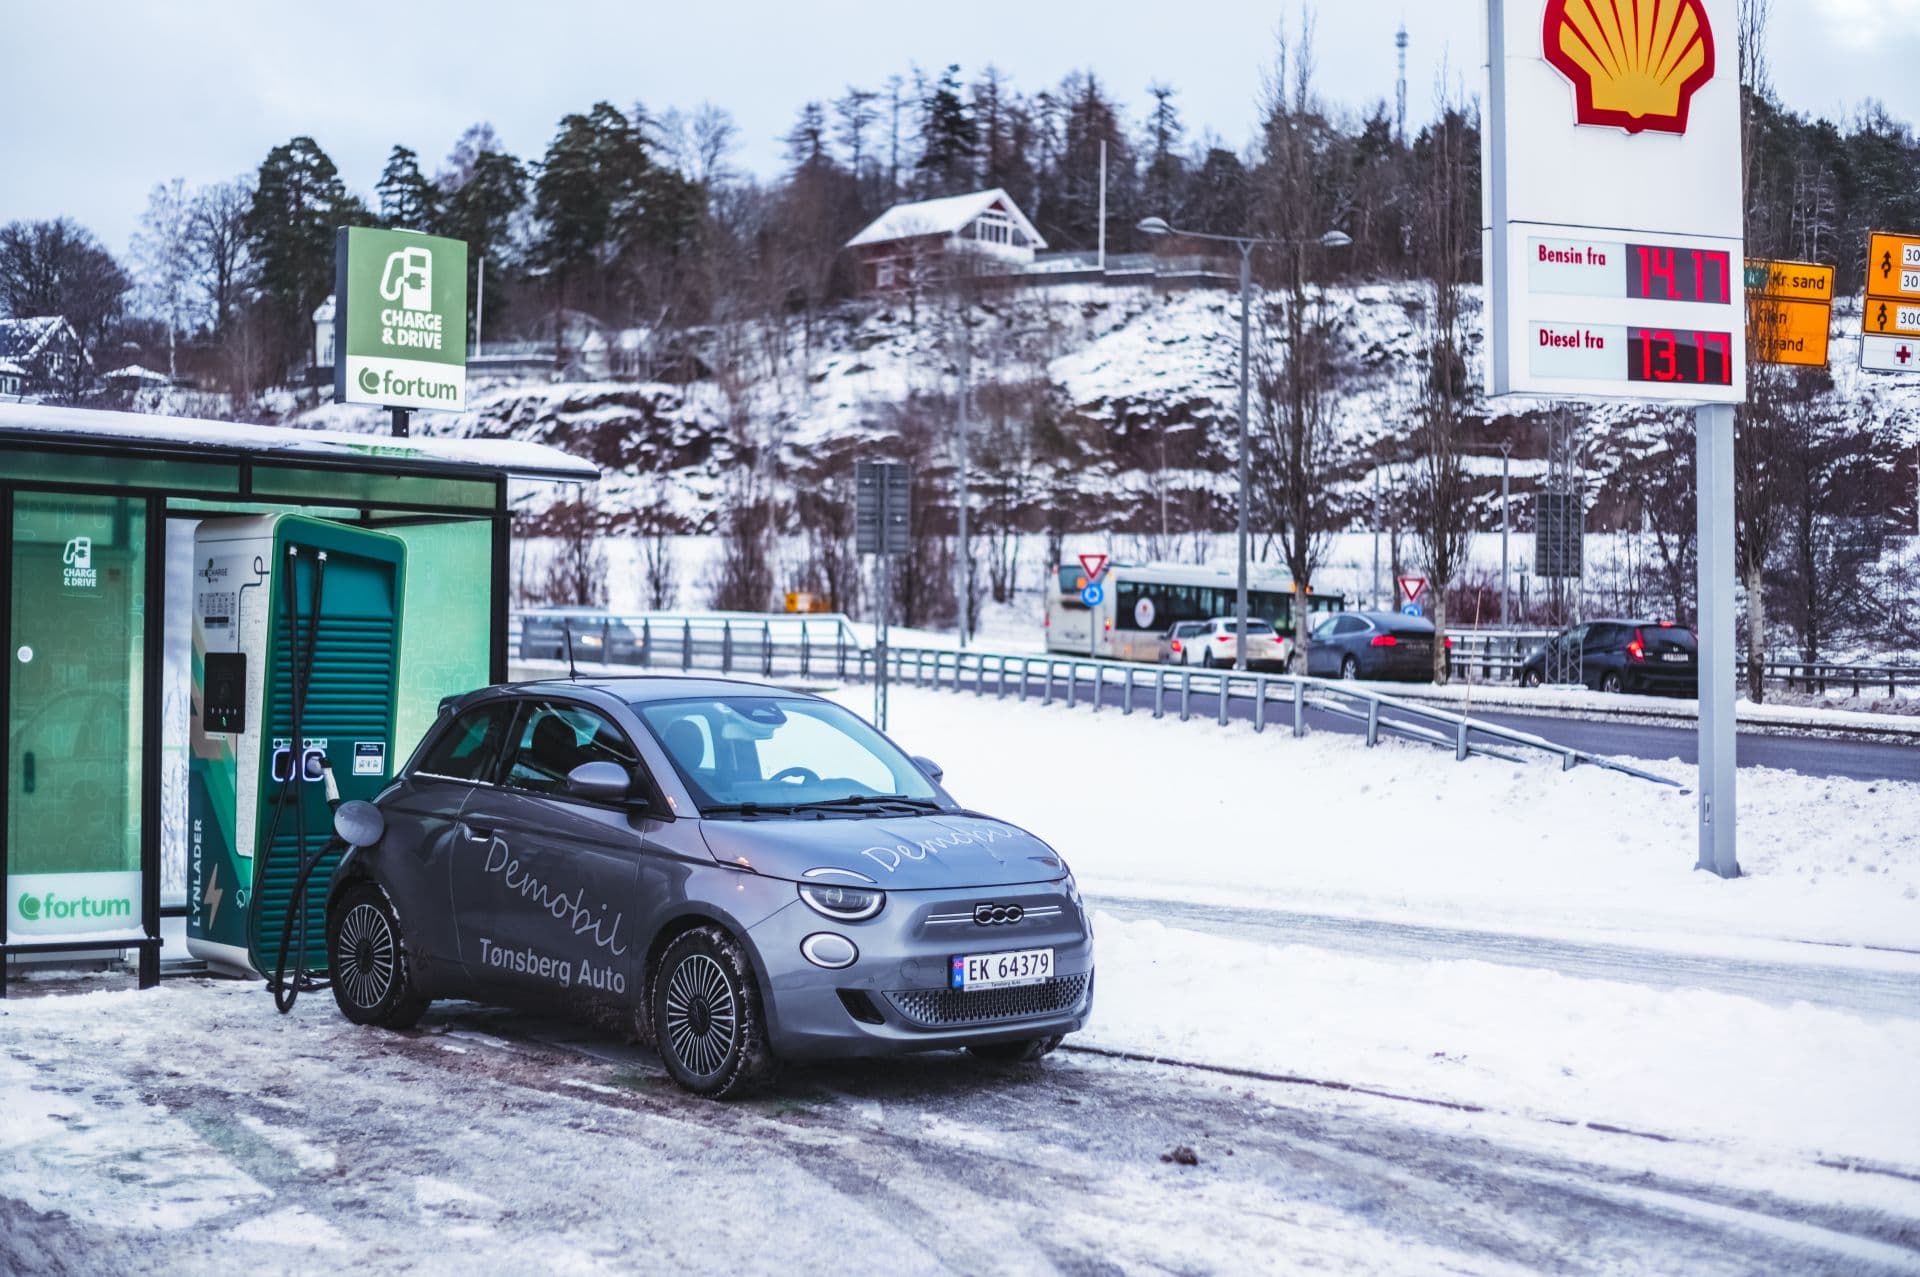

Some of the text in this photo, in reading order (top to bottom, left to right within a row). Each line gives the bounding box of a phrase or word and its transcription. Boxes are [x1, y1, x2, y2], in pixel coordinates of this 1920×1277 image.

[1538, 244, 1606, 266] Bensin fra
[1637, 246, 1729, 303] 14.17
[381, 308, 442, 331] CHARGE
[382, 327, 442, 350] & DRIVE
[1539, 329, 1604, 349] Diesel fra
[1639, 328, 1730, 384] 13.17
[383, 369, 457, 400] fortum
[63, 568, 97, 578] CHARGE
[63, 577, 97, 587] & DRIVE
[193, 819, 202, 927] LYNLADER
[44, 892, 131, 919] fortum
[484, 836, 627, 956] Demobil
[973, 902, 1024, 926] 500
[480, 938, 626, 994] Tønsberg Auto
[969, 953, 1049, 981] EK 64379
